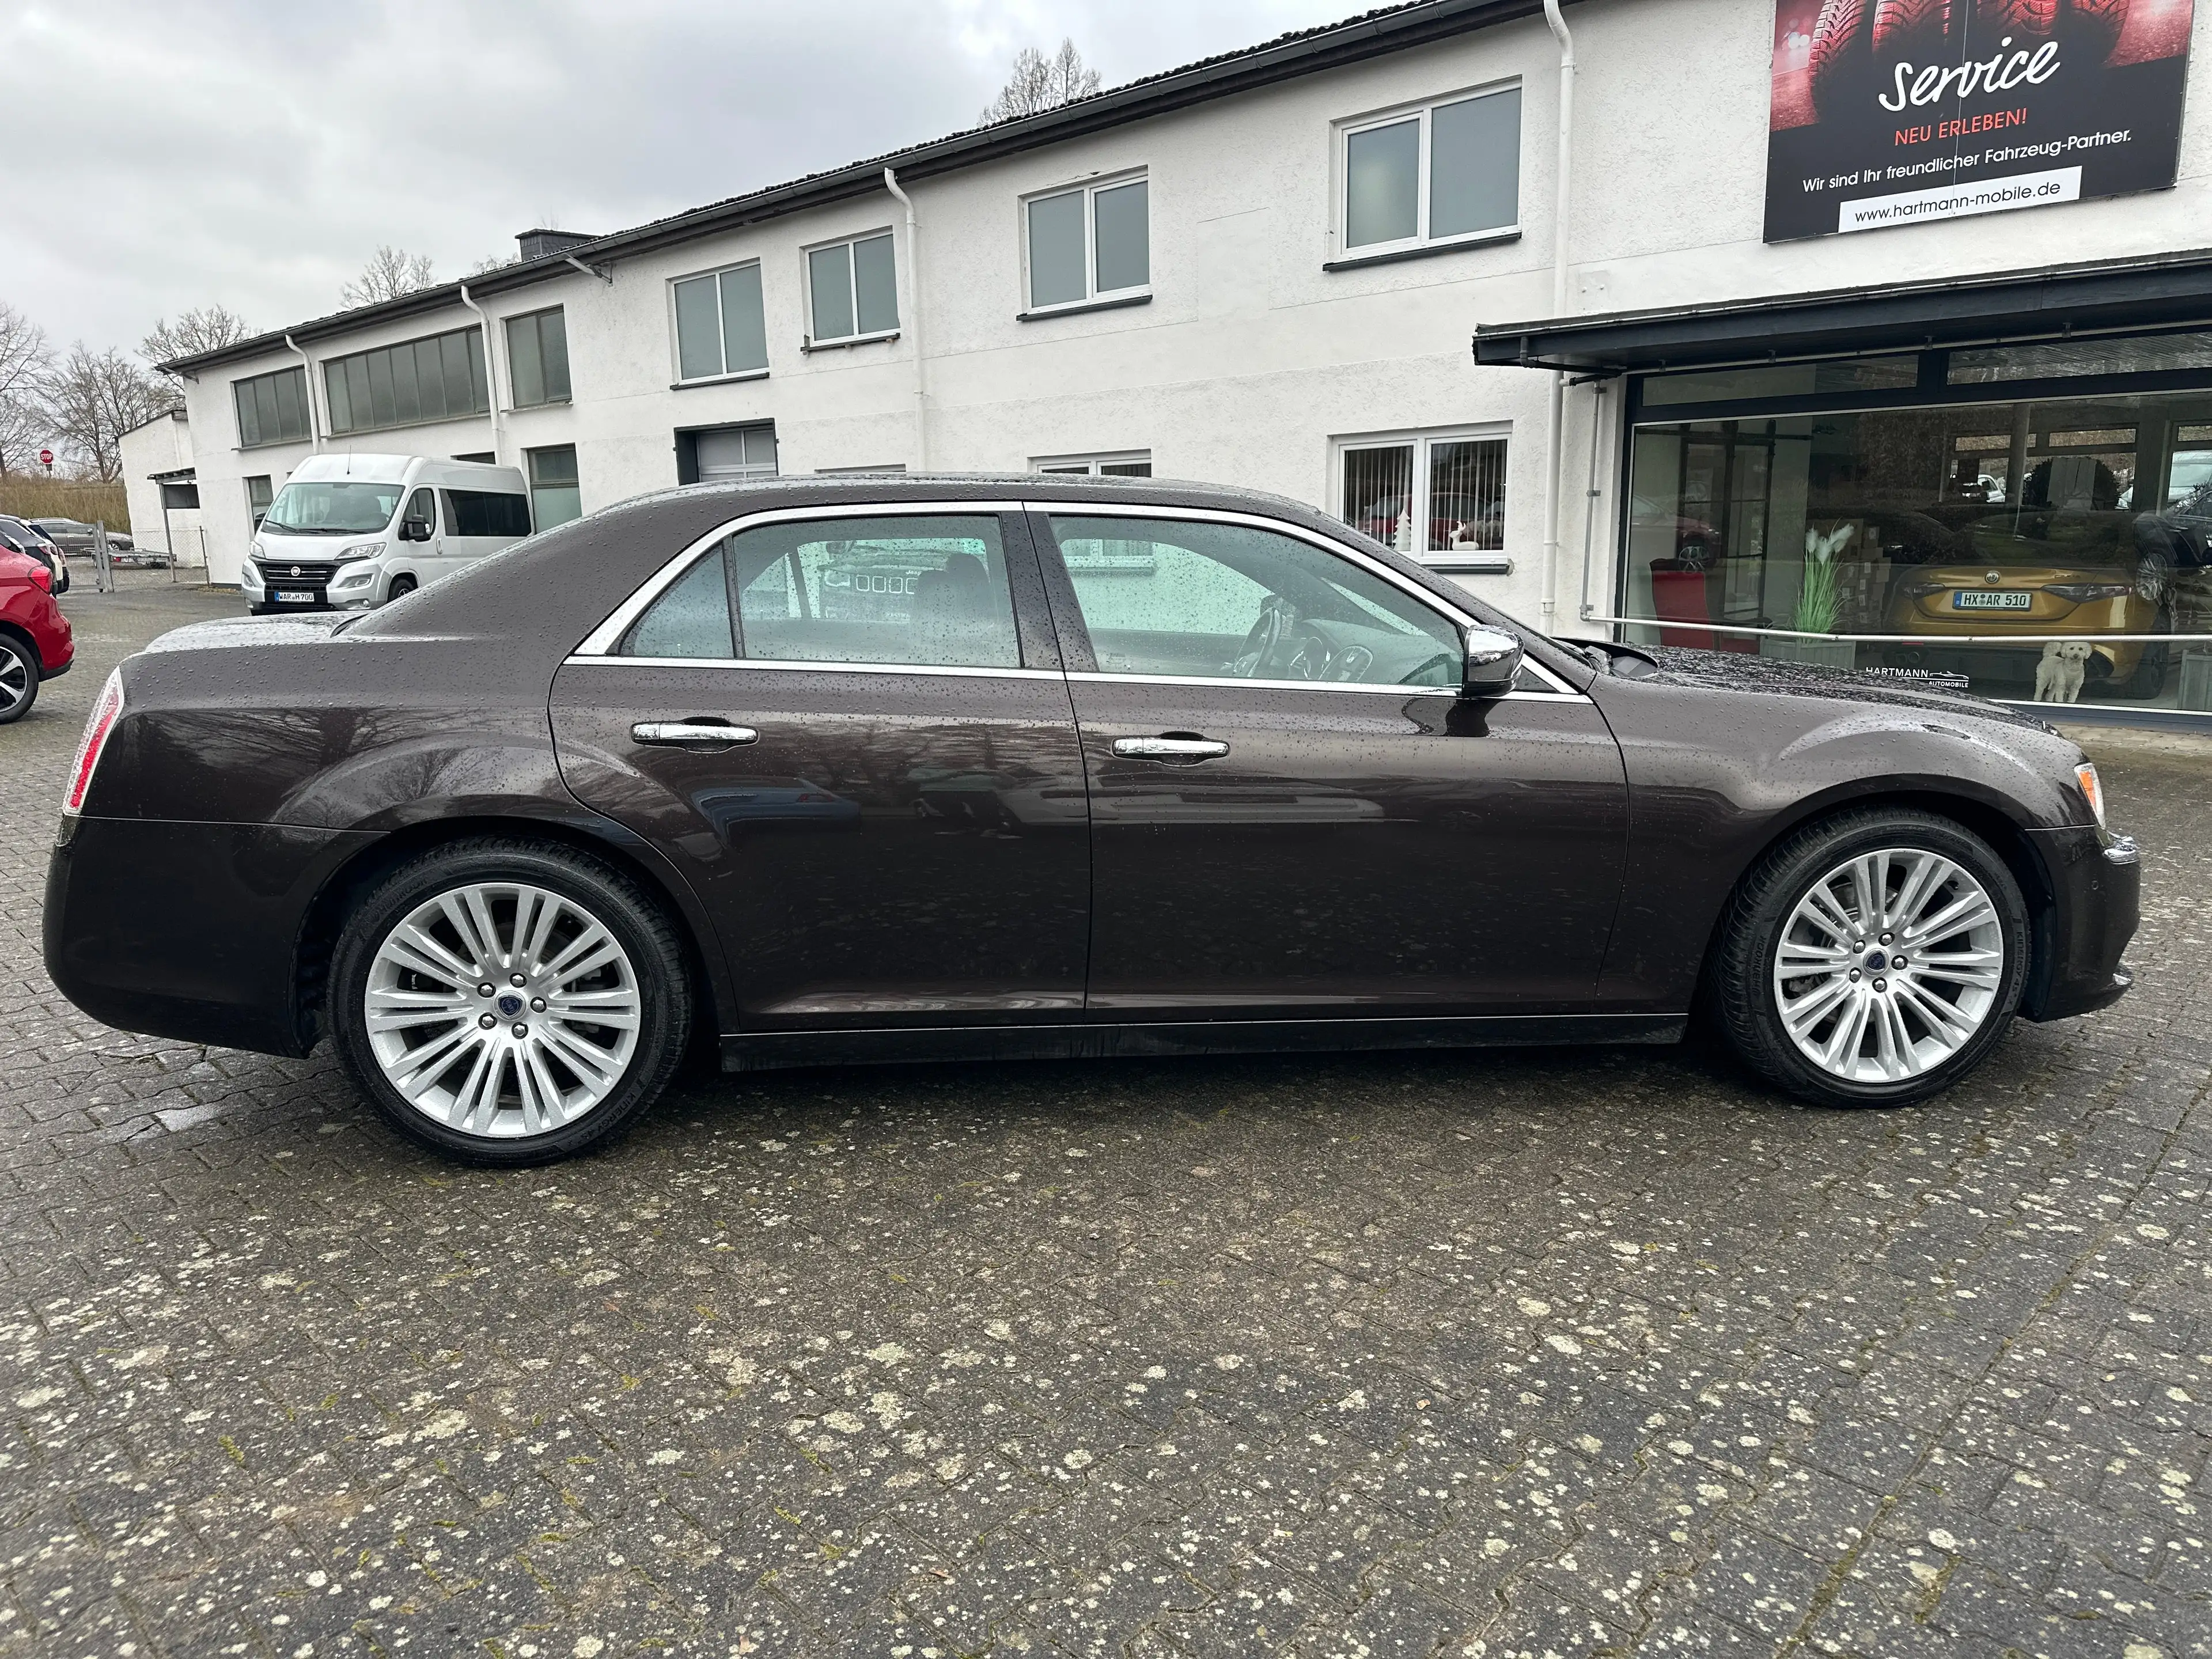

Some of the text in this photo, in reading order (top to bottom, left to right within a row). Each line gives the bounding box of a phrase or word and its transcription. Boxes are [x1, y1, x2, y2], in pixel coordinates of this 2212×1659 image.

[1878, 36, 2061, 111] Service
[1895, 107, 2028, 146] NEU ERLEBEN!
[1802, 128, 2131, 192] Wir sind Ihr freundlicher Fahrzeug-Partner.
[1854, 181, 2061, 222] www.hartmann-mobile.de
[1964, 594, 2027, 606] HX AR 510
[1866, 666, 1929, 678] HARTMANN
